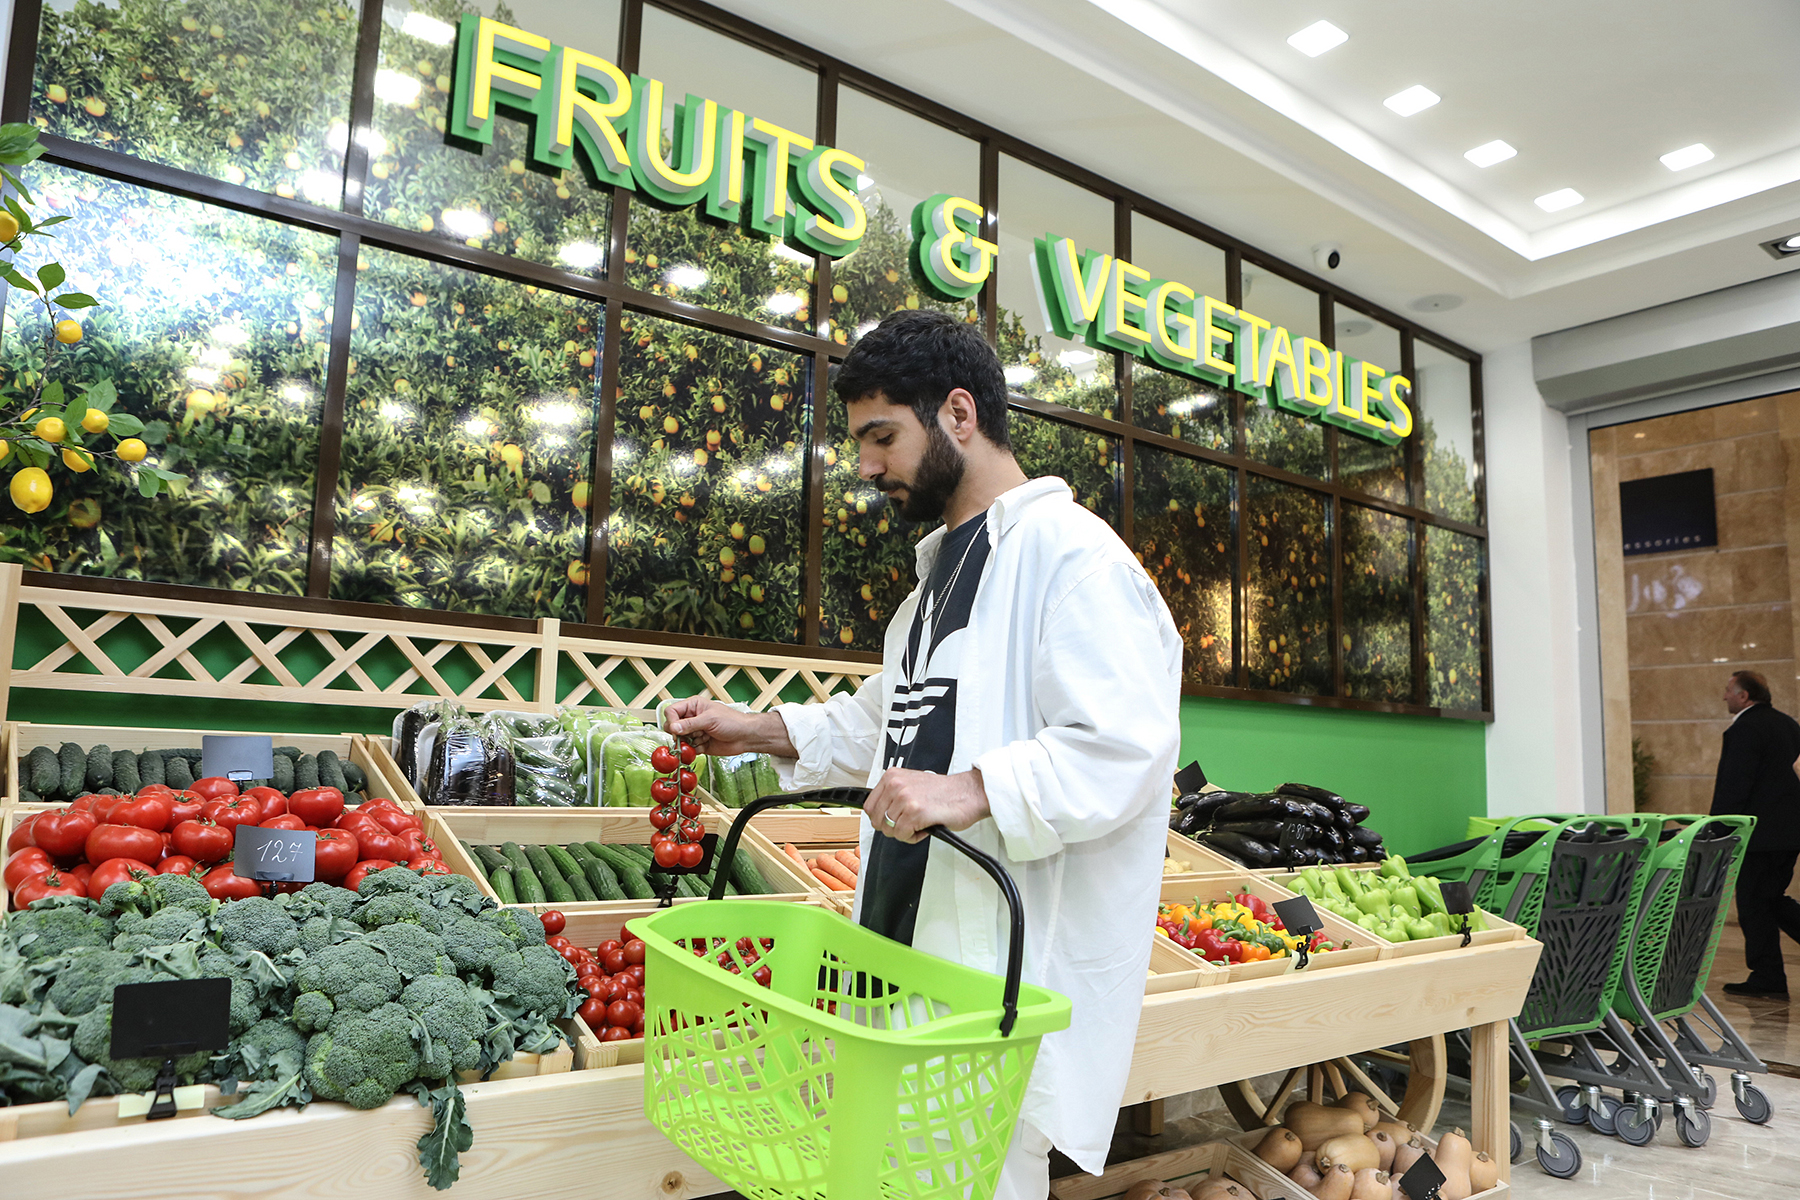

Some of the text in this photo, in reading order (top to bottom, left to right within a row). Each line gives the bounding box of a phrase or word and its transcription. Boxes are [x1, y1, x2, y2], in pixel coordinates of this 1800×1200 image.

[467, 16, 1414, 440] FRUITS & VEGETABLES
[256, 839, 303, 863] 127
